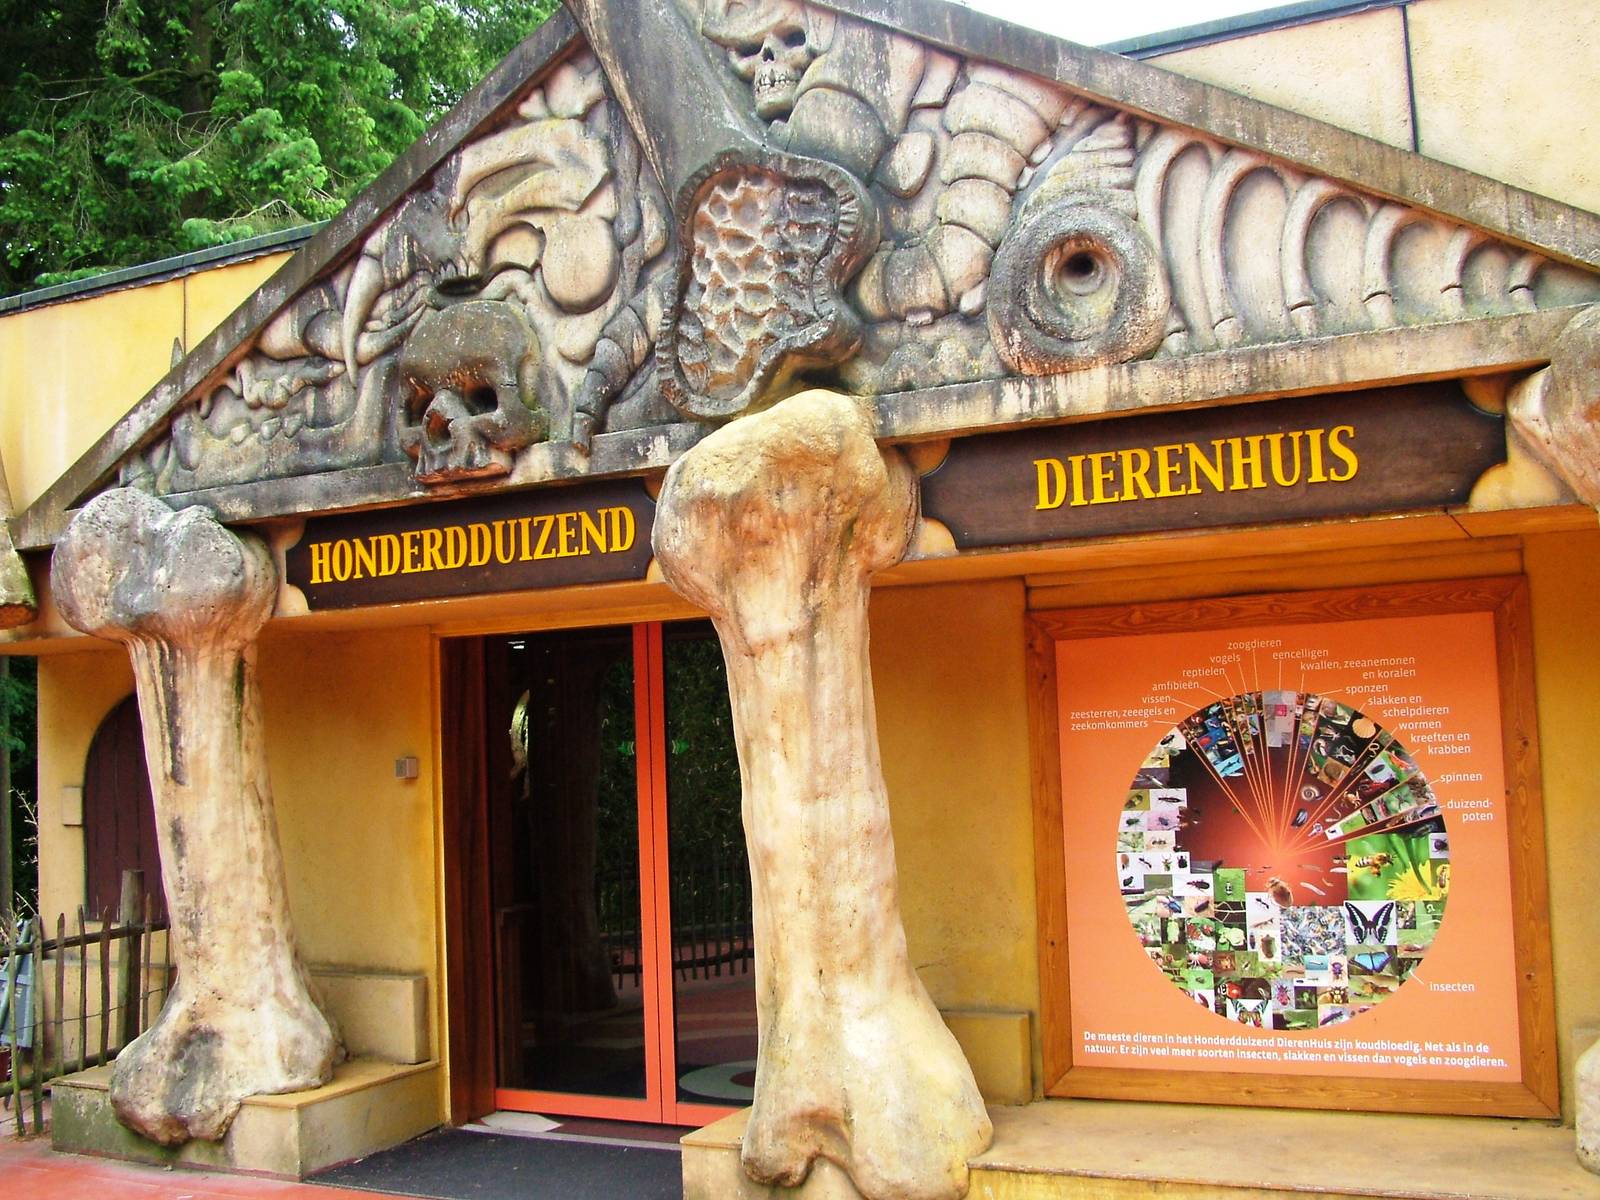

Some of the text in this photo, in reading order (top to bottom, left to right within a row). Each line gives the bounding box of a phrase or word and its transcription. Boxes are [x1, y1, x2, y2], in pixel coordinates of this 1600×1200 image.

[1033, 425, 1359, 510] DIERENHUIS
[309, 506, 636, 584] HONDERDDUIZEND
[1227, 638, 1282, 651] zoogdieren
[1210, 653, 1241, 665] vogels
[1272, 648, 1329, 660] eencelligen
[1300, 656, 1415, 670] kwallen, zeeanemonen
[1182, 667, 1225, 678] reptielen
[1362, 668, 1416, 679] en koralen
[1345, 684, 1388, 694] sponzen
[1142, 694, 1171, 704] vissen
[1368, 695, 1422, 706] slakken en
[1070, 706, 1176, 720] zeesterren, zeeegels en
[1382, 705, 1449, 717] schelpdieren
[1071, 719, 1149, 731] zeekomkommers
[1398, 721, 1441, 730] wormen
[1410, 732, 1470, 743] kreeften en
[1428, 745, 1471, 755] krabben
[1440, 772, 1483, 784] spinnen
[1447, 798, 1493, 809] duizend-
[1462, 812, 1493, 823] poten
[1429, 981, 1475, 992] insecten
[1084, 1031, 1489, 1053] De meeste dieren in het Honderdduizend DierenHuis zijn koudbloedig. Net als in de
[1084, 1044, 1508, 1068] natuur. Er zijn veel meer soorten insecten, slakken en vissen dan vogels en zoogdieren.
